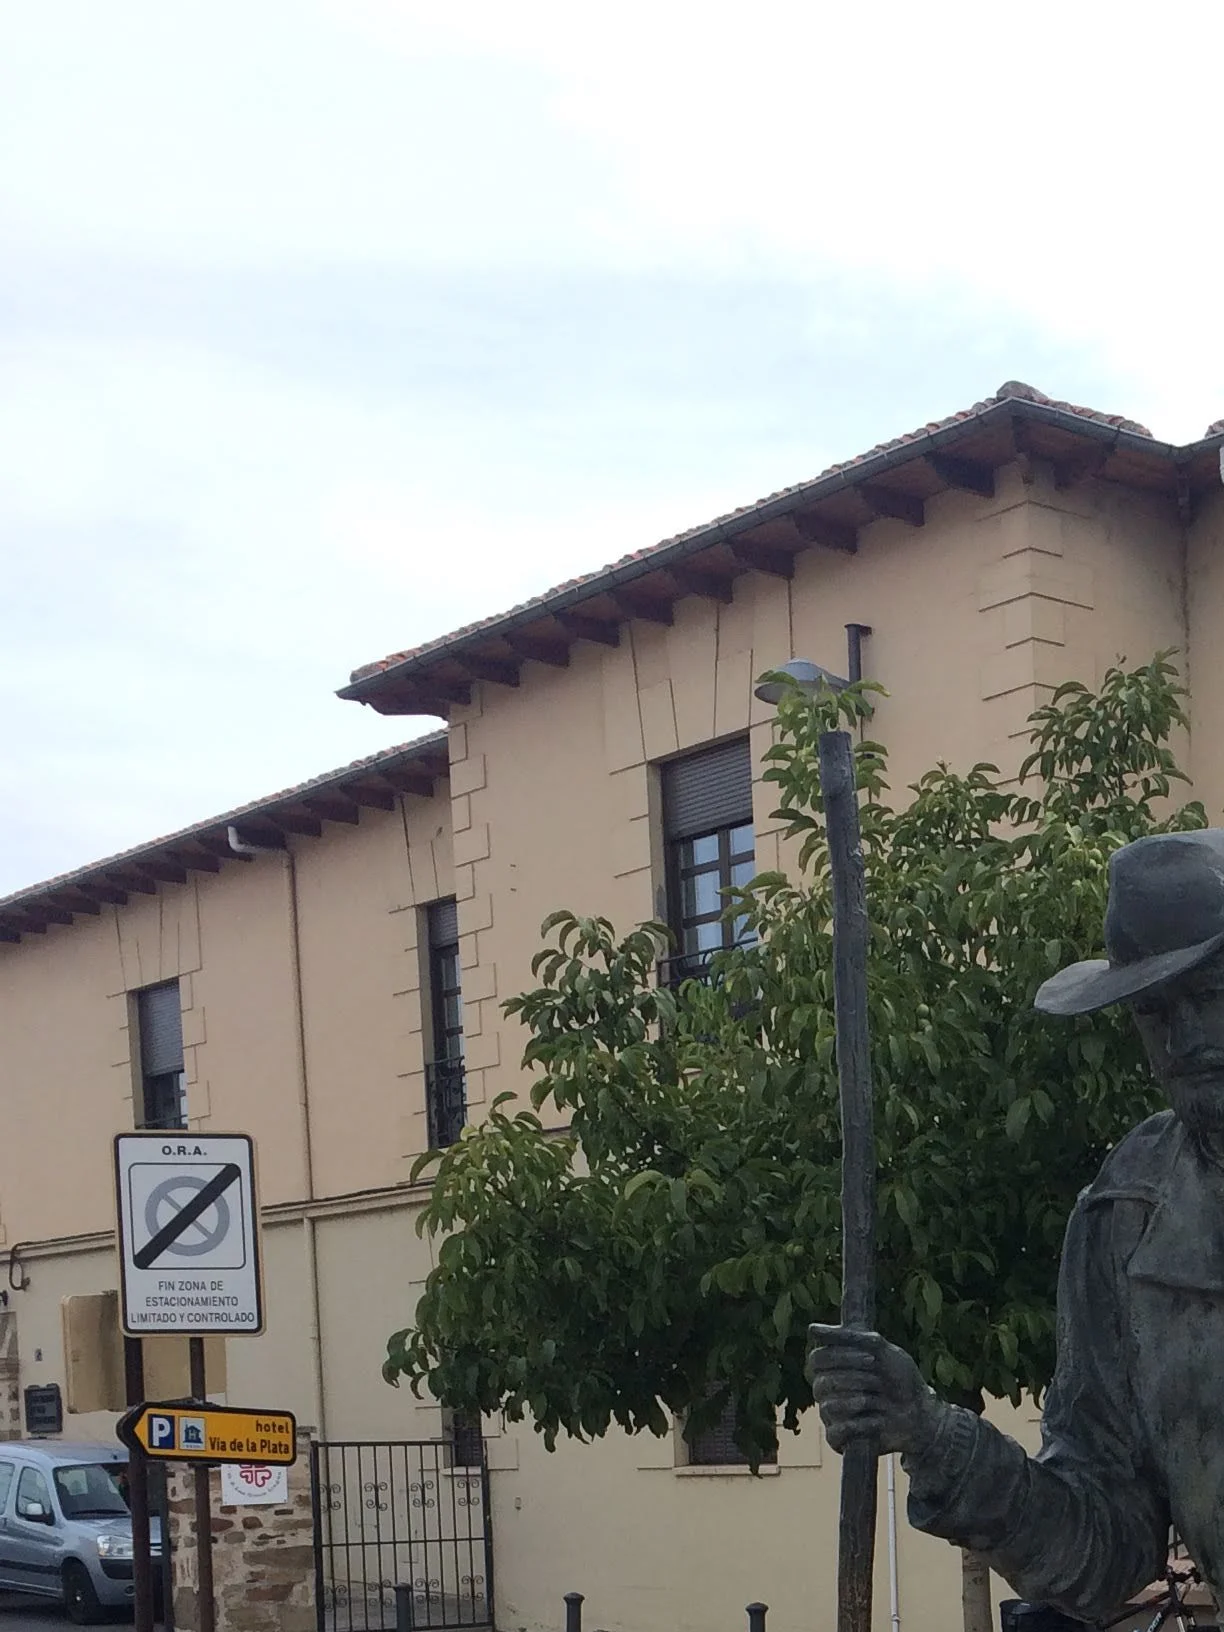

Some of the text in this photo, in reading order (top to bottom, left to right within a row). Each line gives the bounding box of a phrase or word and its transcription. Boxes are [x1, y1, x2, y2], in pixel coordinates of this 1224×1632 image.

[161, 1145, 208, 1156] O.R.A.
[158, 1280, 224, 1291] FIN ZONA DE
[145, 1296, 239, 1307] ESTACIONAMIENTO
[130, 1311, 255, 1323] LIMITADO Y CONTROLADO
[152, 1417, 171, 1447] P
[255, 1420, 290, 1434] hotel
[229, 1437, 244, 1452] de
[246, 1437, 257, 1453] la
[260, 1438, 290, 1454] Plata
